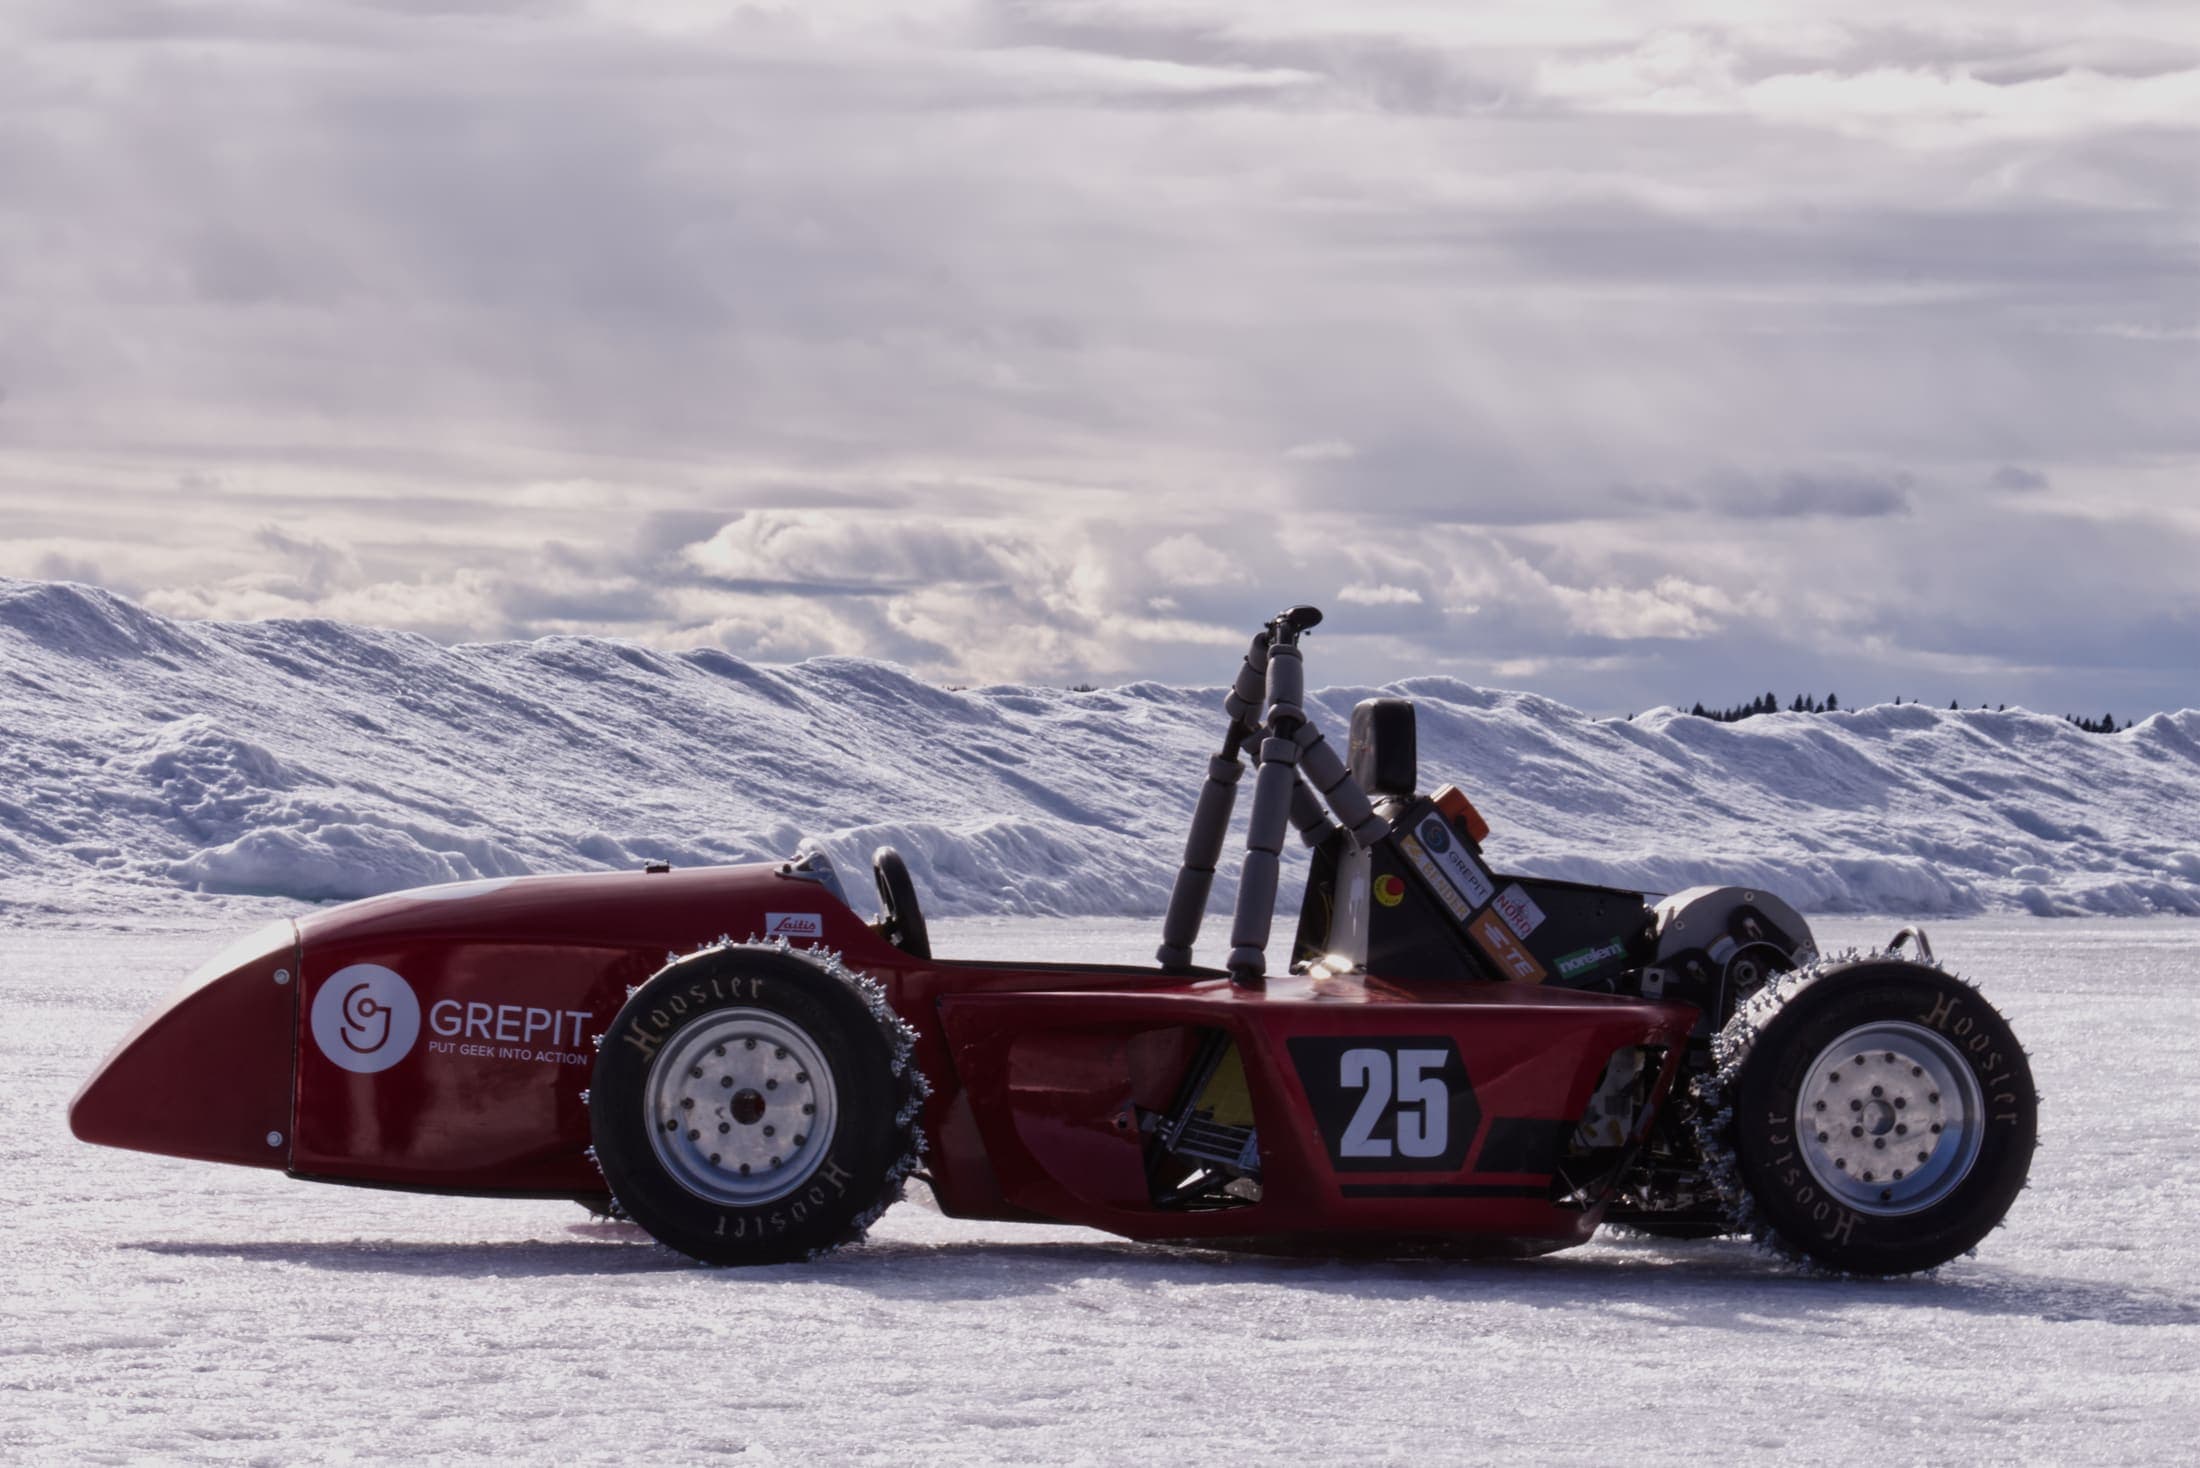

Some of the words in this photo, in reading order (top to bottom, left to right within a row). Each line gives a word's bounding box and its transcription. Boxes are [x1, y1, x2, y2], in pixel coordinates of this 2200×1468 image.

[1448, 851, 1488, 897] GREPIT
[1497, 895, 1532, 936] NORD
[428, 1041, 456, 1053] PUT
[459, 1044, 495, 1057] GEEK
[499, 1047, 532, 1061] INTO
[535, 1051, 588, 1065] ACTION
[430, 999, 593, 1047] GREPIT
[624, 974, 765, 1064] Hoosier
[1917, 991, 2018, 1126] Hoosier
[1340, 1048, 1449, 1158] 25
[1765, 1111, 1866, 1246] Hoosier
